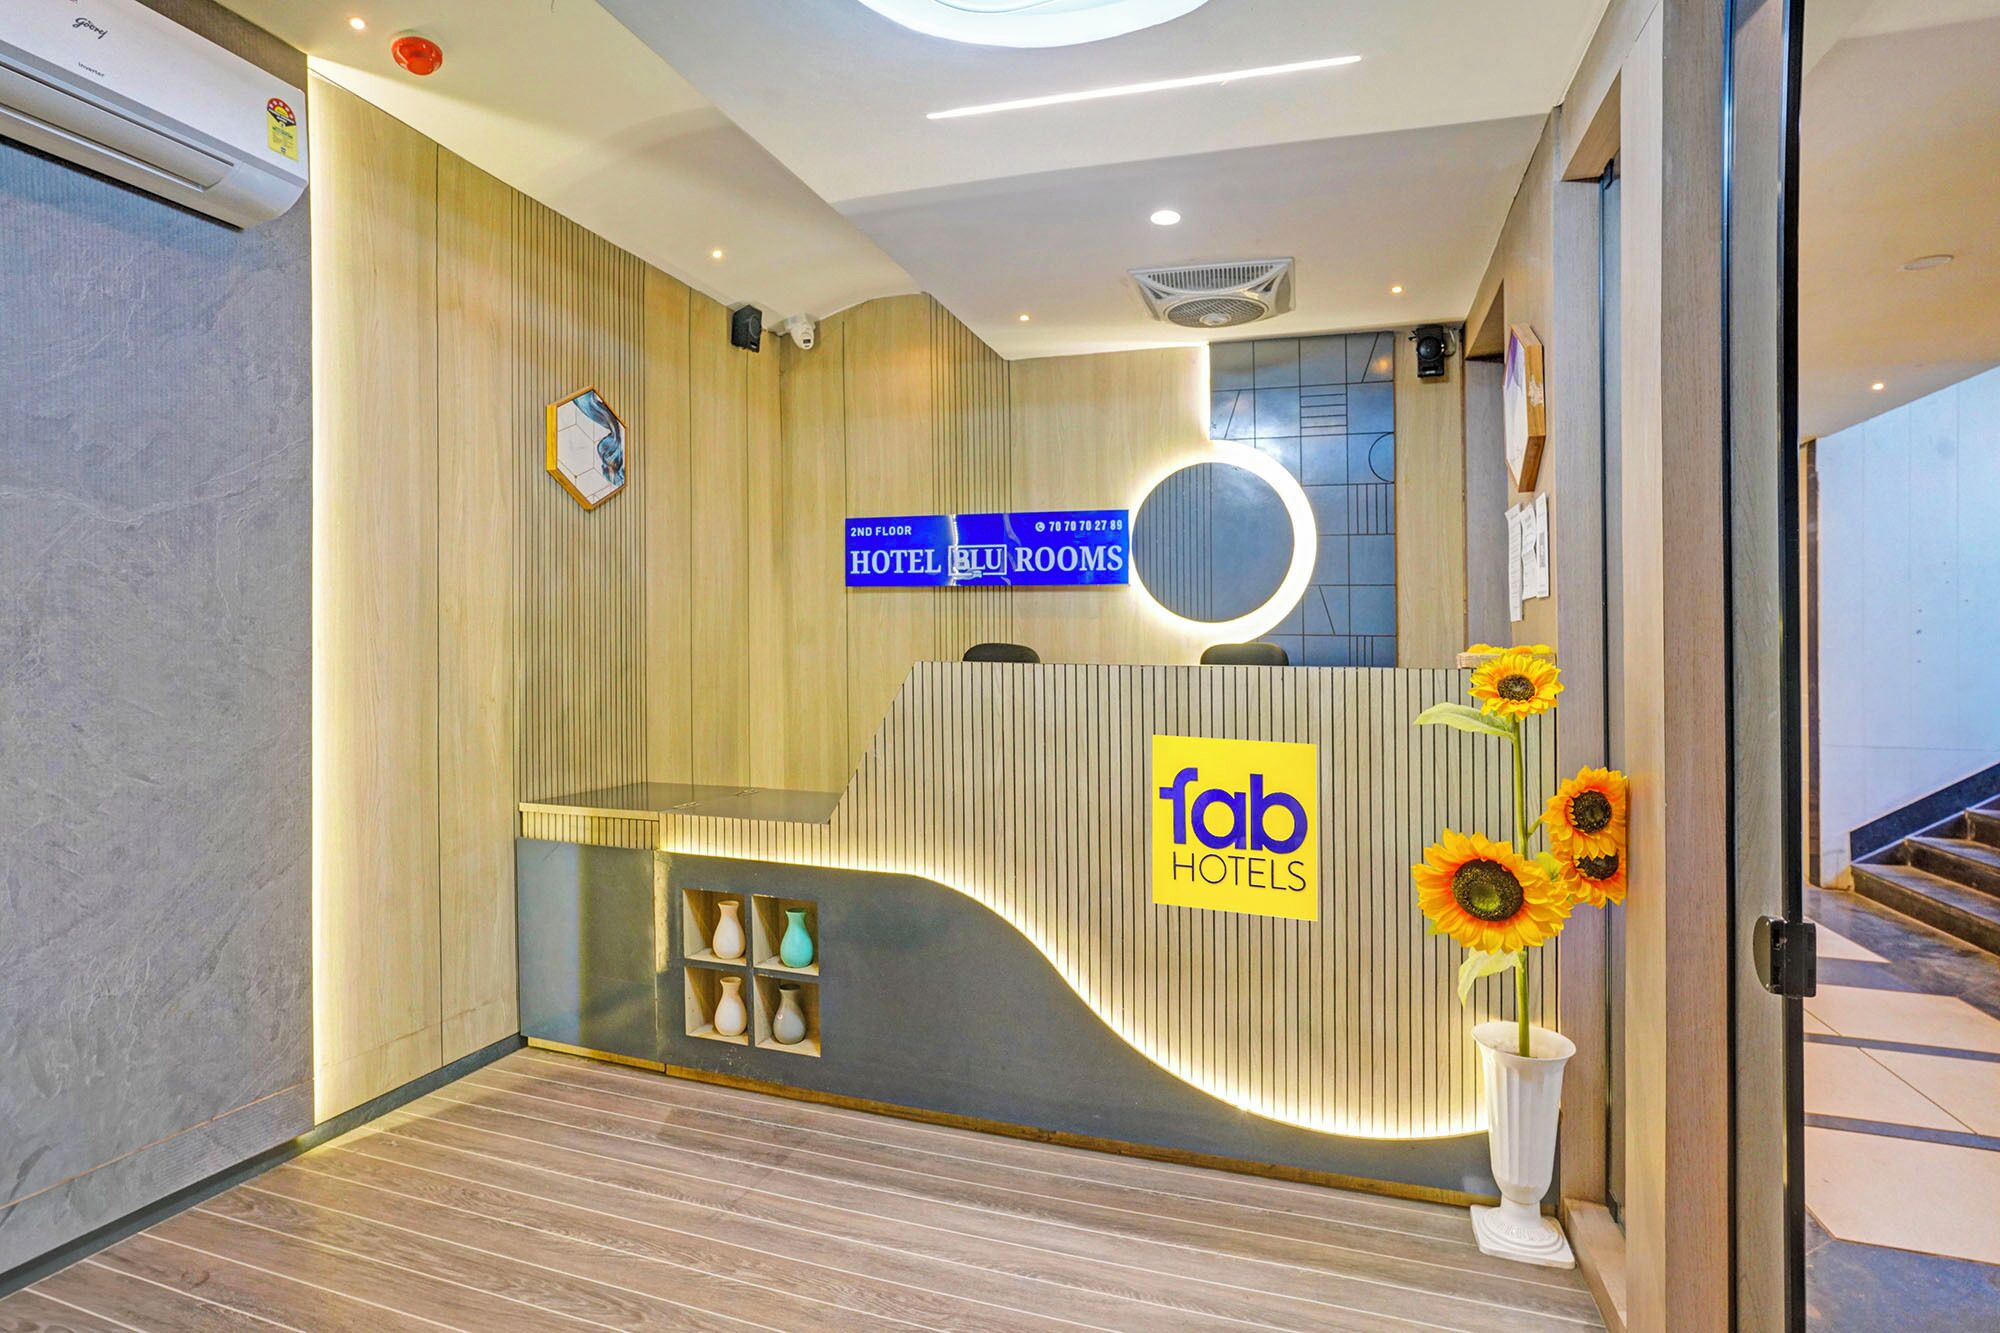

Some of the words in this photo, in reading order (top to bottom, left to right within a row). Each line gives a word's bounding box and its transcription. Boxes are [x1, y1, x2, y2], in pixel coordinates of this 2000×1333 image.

[850, 527, 872, 537] 2ND
[875, 525, 912, 536] FLOOR
[1048, 521, 1061, 532] 70
[1064, 520, 1077, 532] 70
[1079, 520, 1092, 531] 70
[1094, 519, 1107, 531] 27
[1110, 519, 1123, 530] 89
[850, 549, 942, 575] HOTEL
[953, 548, 1003, 570] BLU
[1014, 545, 1123, 572] ROOMS
[1159, 767, 1308, 854] fab
[1173, 851, 1306, 892] HOTELS
